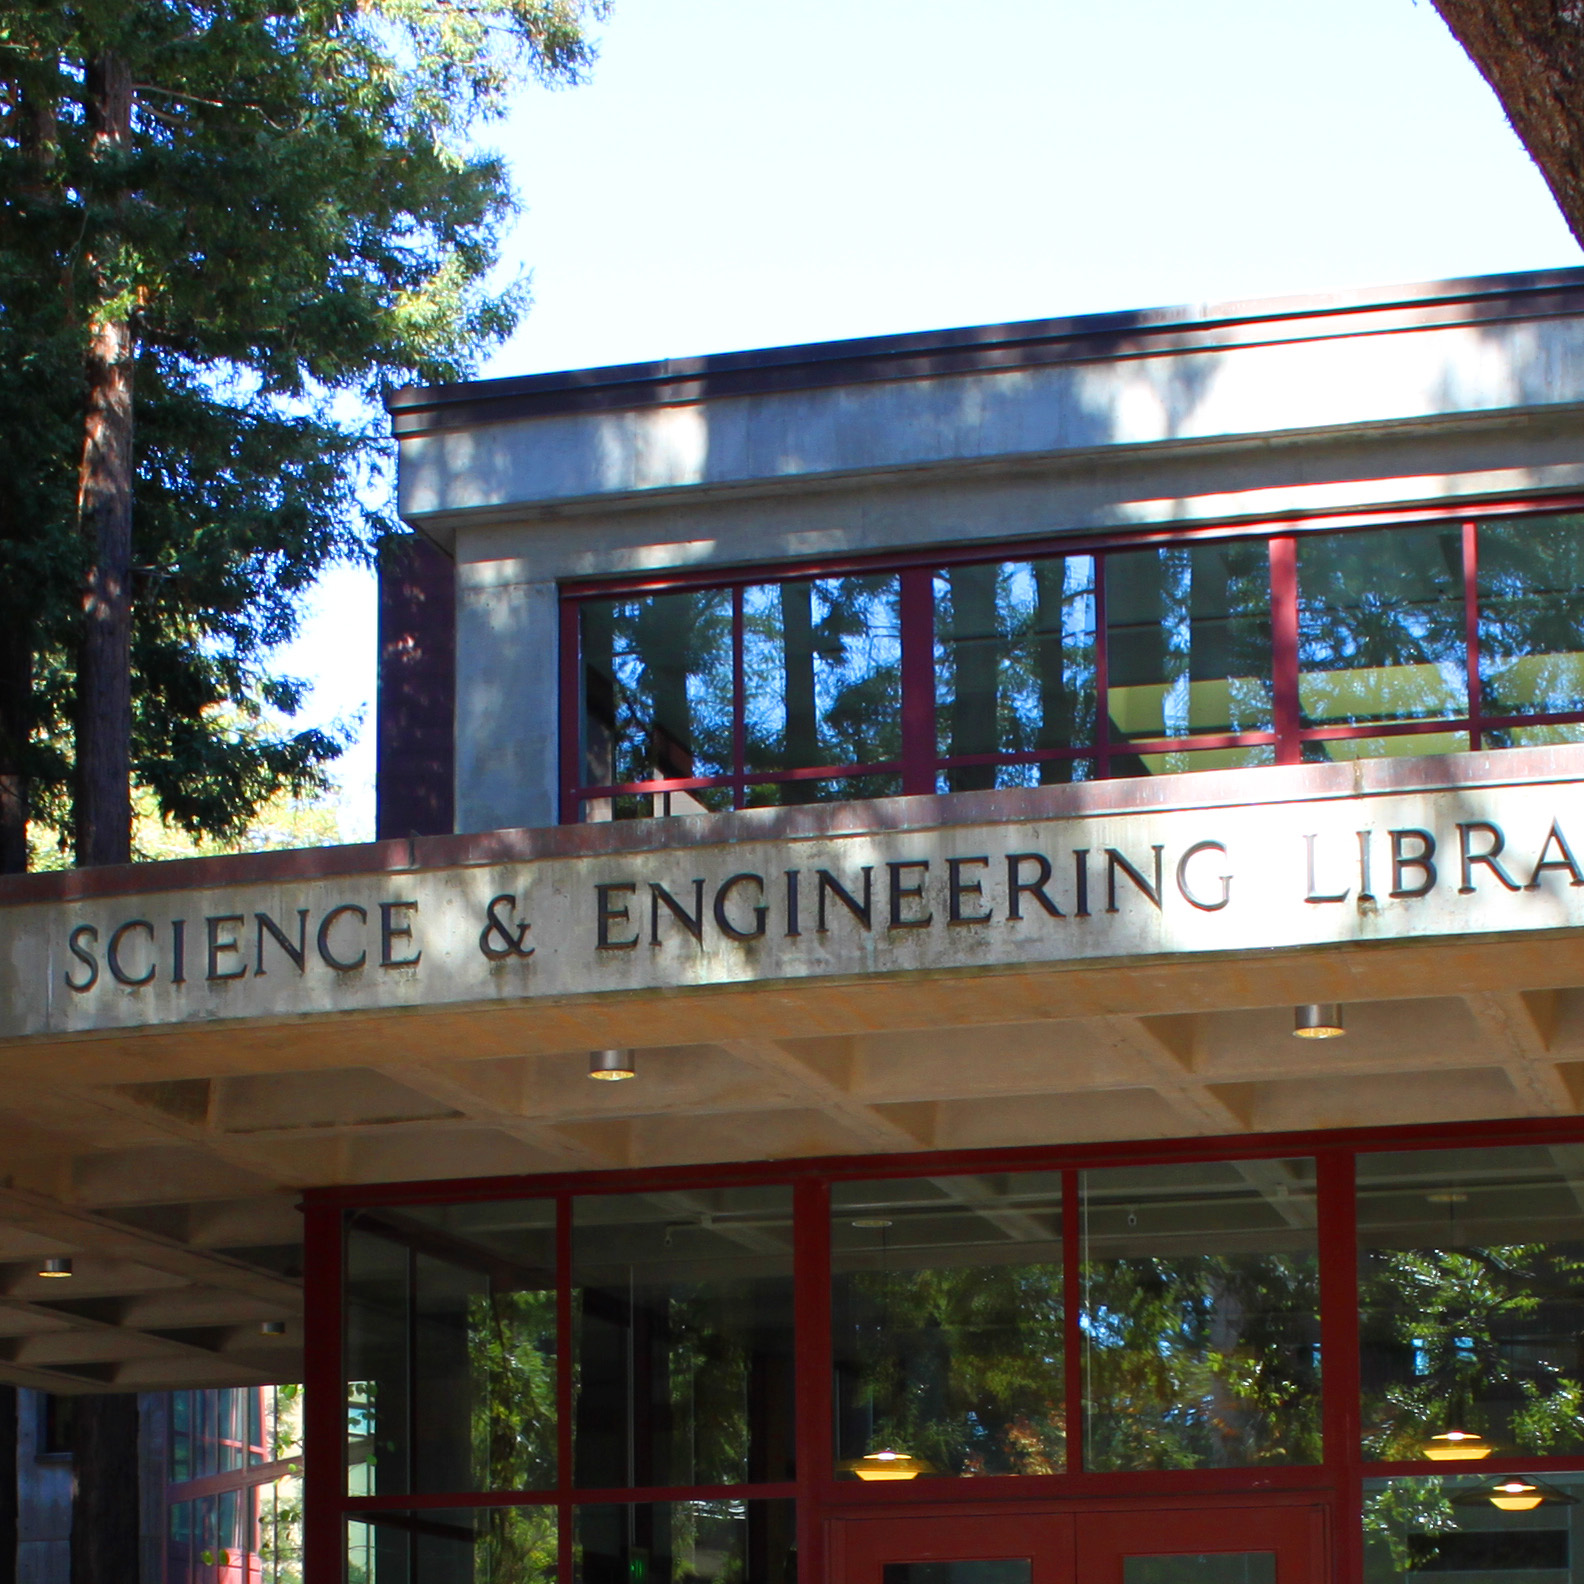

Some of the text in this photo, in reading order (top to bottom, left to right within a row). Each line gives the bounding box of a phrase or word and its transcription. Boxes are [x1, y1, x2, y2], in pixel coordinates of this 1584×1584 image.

[65, 902, 422, 993] SCIENCE
[479, 894, 535, 960] &
[595, 840, 1234, 950] ENGINEERING
